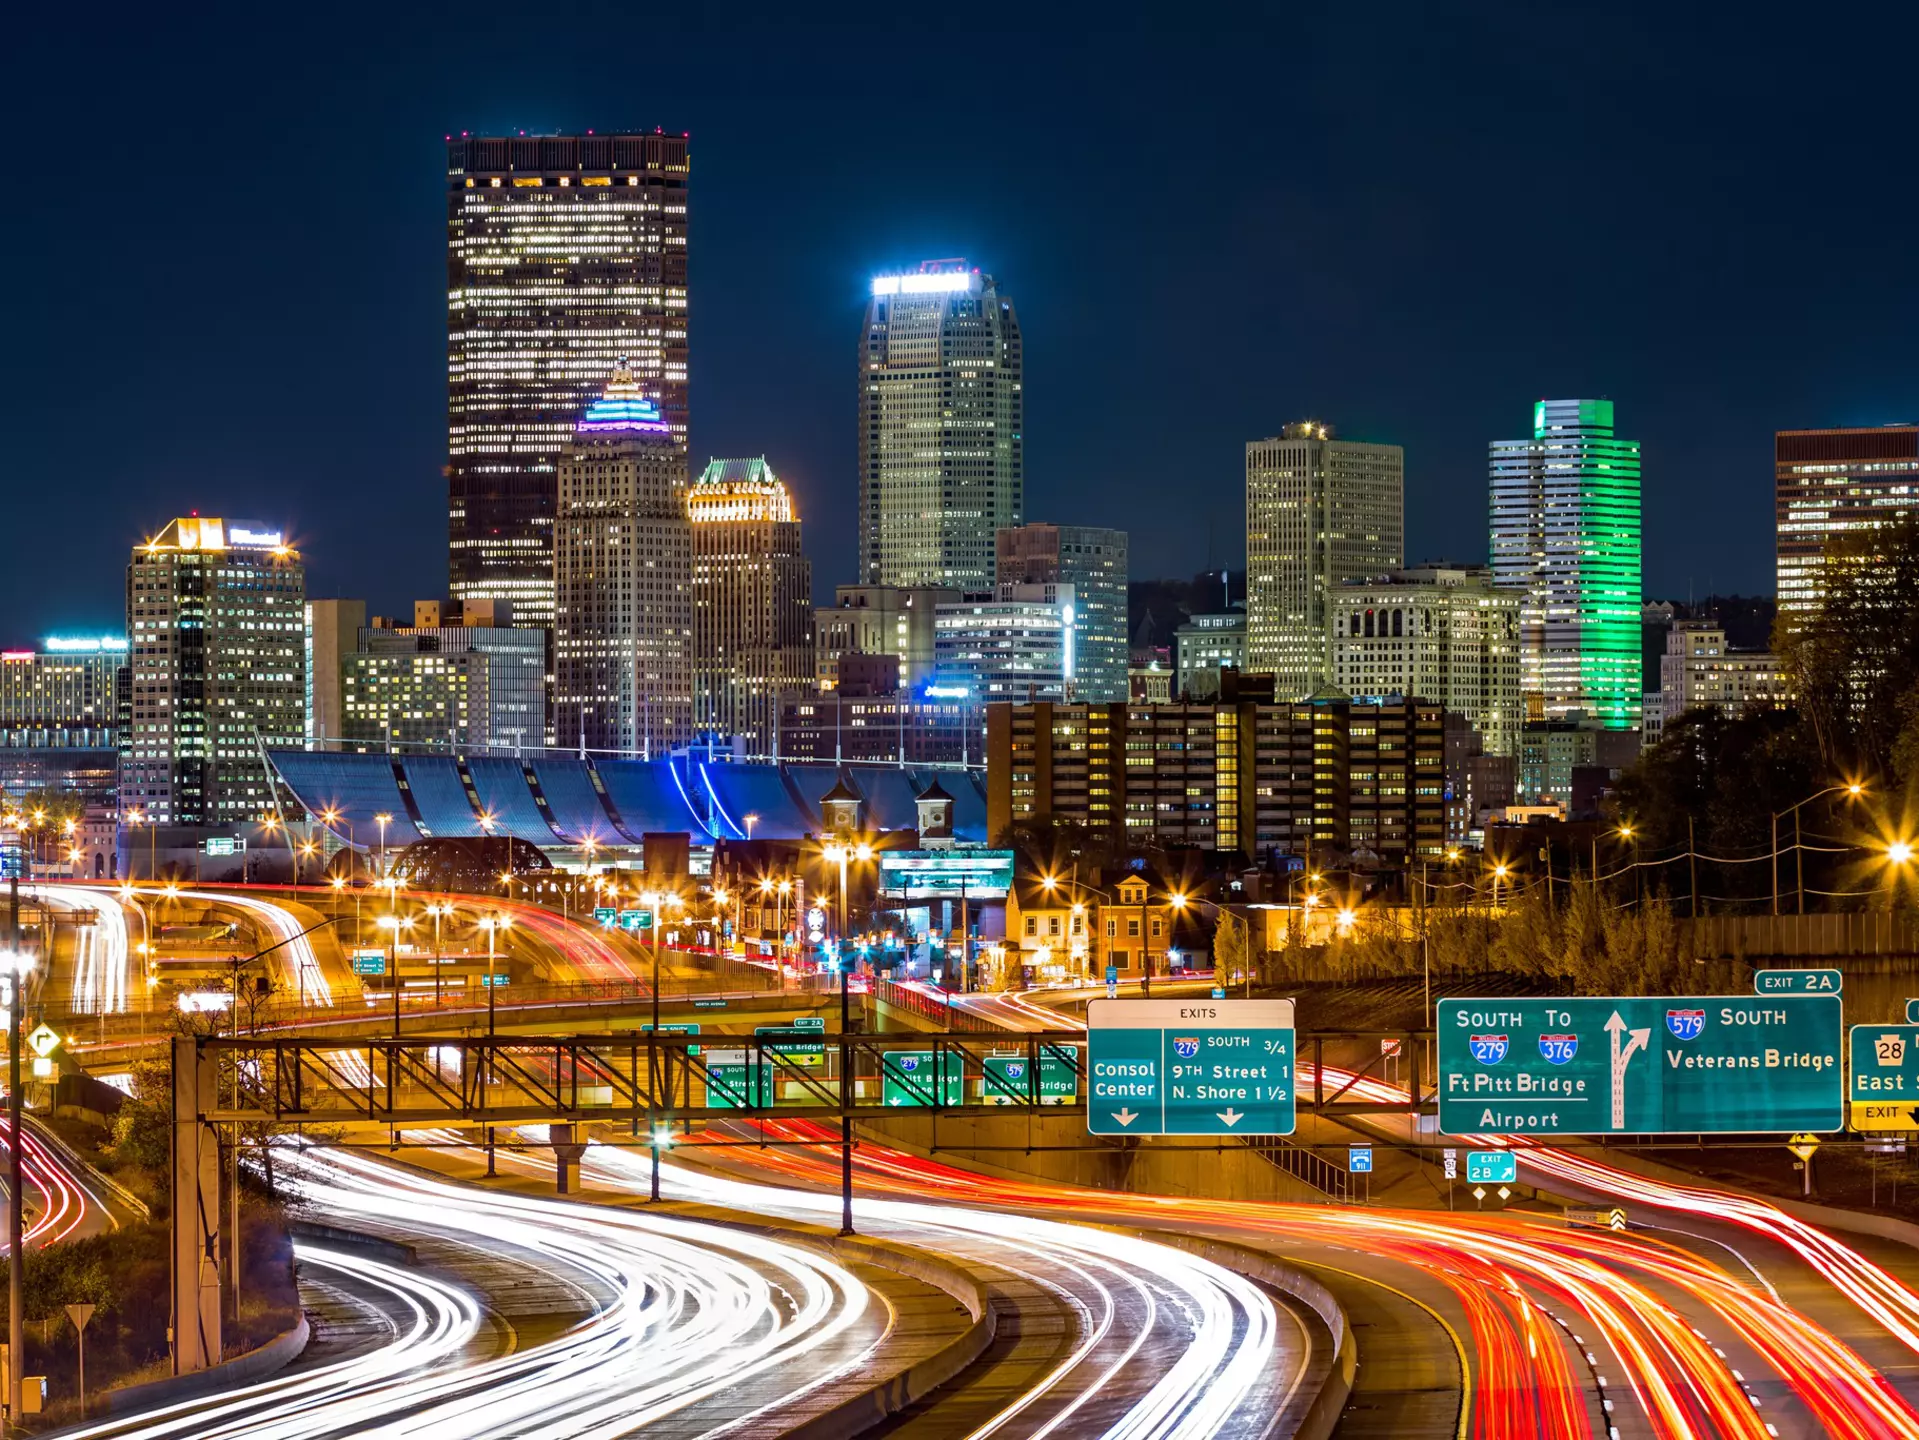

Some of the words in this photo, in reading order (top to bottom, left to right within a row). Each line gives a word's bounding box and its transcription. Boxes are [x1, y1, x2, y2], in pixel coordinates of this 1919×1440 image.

[1765, 977, 1793, 988] EXIT
[1804, 975, 1833, 990] 2A
[1180, 1008, 1217, 1018] EXITS
[1456, 1010, 1522, 1028] SOUTH
[1673, 1017, 1702, 1034] 579
[1720, 1008, 1787, 1026] SOUTH
[1178, 1042, 1200, 1054] 279
[1207, 1036, 1250, 1047] SOUTH
[1264, 1040, 1286, 1055] 3/4
[1476, 1042, 1505, 1060] 279
[1544, 1042, 1574, 1060] 376
[1879, 1042, 1902, 1059] 28
[1666, 1050, 1760, 1068] Veterans
[1764, 1048, 1834, 1072] Bridge
[1094, 1062, 1155, 1076] Consol
[1172, 1066, 1202, 1078] 9TH
[1213, 1066, 1267, 1079] Street
[1282, 1066, 1288, 1078] 1
[1095, 1083, 1154, 1096] Center
[1448, 1074, 1470, 1092] Ft
[1474, 1074, 1512, 1092] Pitt
[1517, 1074, 1586, 1096] Bridge
[1857, 1075, 1904, 1090] East
[1172, 1086, 1190, 1099] N.
[1196, 1086, 1247, 1099] Shore
[1479, 1108, 1558, 1130] Airport
[1866, 1106, 1900, 1118] EXIT
[1356, 1162, 1365, 1170] 911
[1481, 1155, 1501, 1163] EXIT
[1472, 1167, 1492, 1178] 2B
